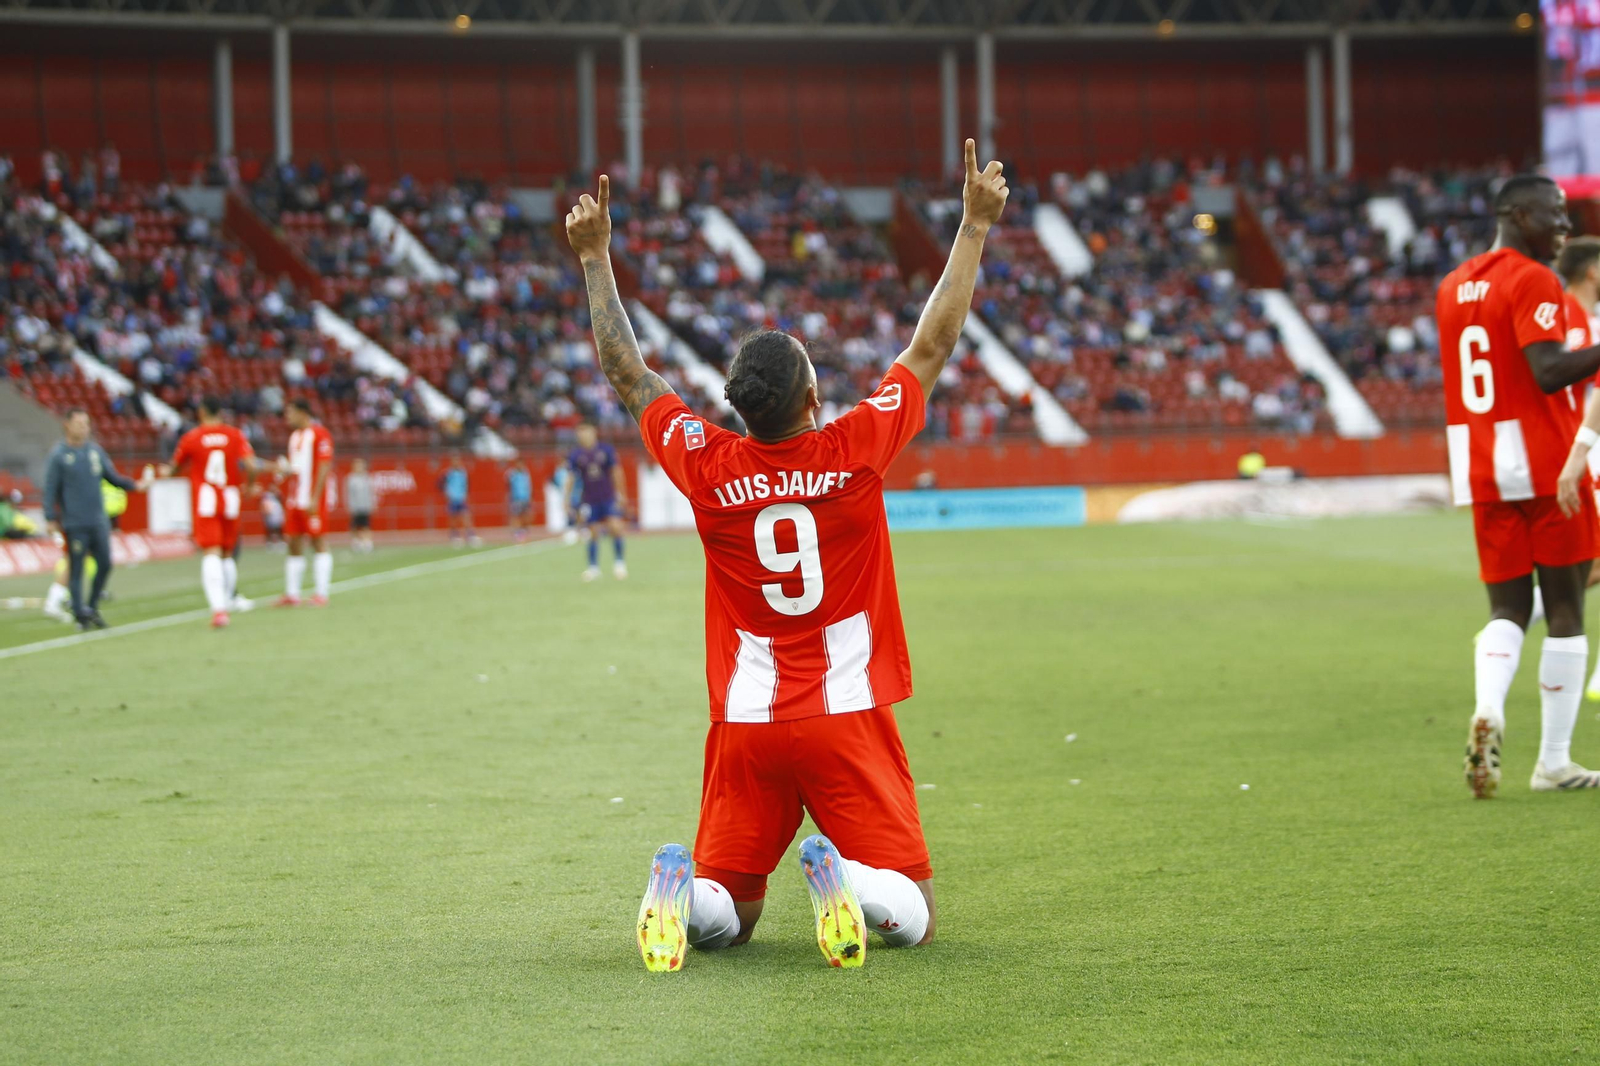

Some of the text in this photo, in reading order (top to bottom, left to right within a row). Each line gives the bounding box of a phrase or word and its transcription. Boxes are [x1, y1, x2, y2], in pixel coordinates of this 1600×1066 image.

[1458, 324, 1495, 415] 6
[204, 448, 228, 488] 4
[714, 470, 853, 507] LUIS JAVER
[754, 502, 824, 616] 9
